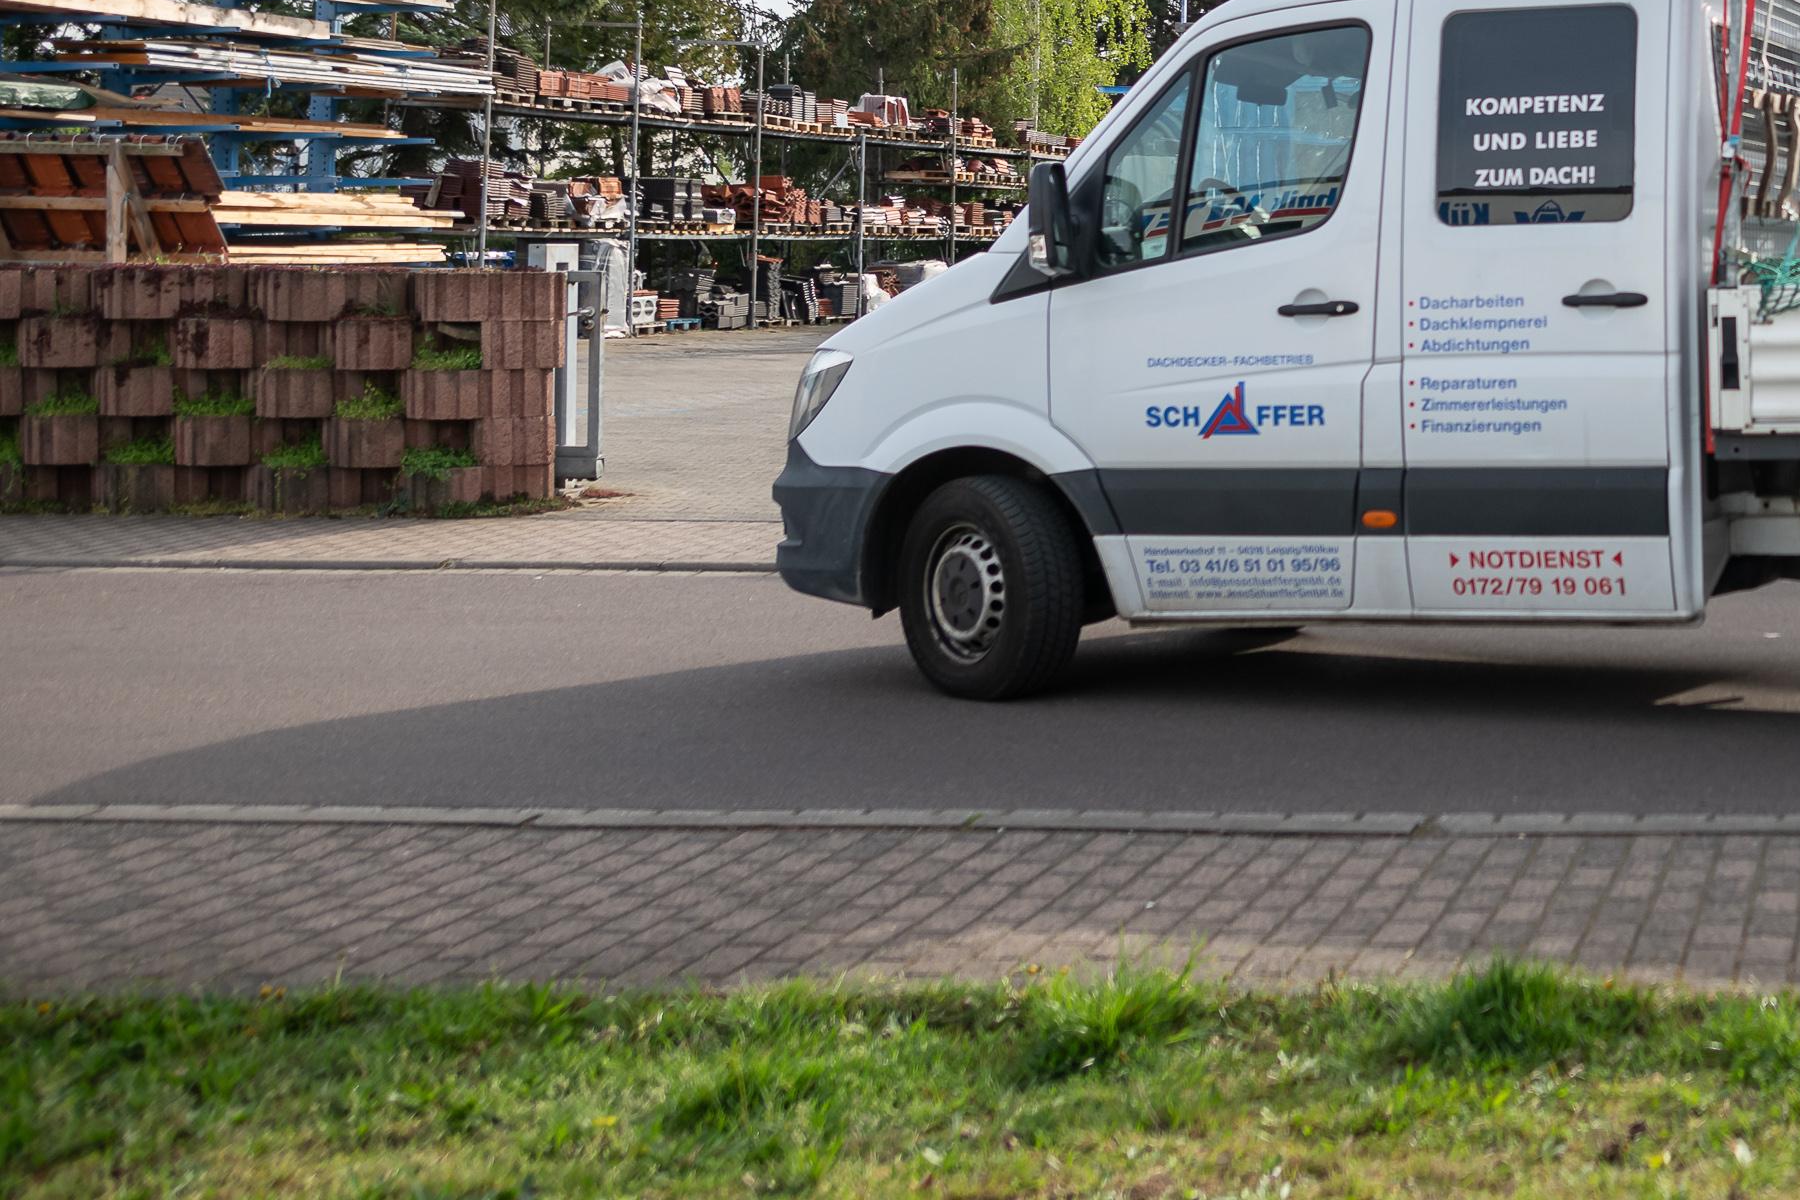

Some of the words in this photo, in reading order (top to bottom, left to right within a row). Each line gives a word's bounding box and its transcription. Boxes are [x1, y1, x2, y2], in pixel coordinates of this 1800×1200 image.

[1465, 94, 1605, 116] KOMPETENZ
[1473, 132, 1527, 151] UND
[1535, 130, 1598, 149] LIEBE
[1474, 168, 1524, 187] ZUM
[1529, 166, 1596, 186] DACH!
[1419, 296, 1525, 310] Dacharbeiten
[1419, 316, 1548, 331] Dachklempnerei
[1421, 339, 1530, 354] Abdichtungen
[1147, 354, 1314, 368] DACHDECKER-FACHBETRIEB
[1420, 376, 1518, 393] Reparaturen
[1421, 398, 1568, 414] Zimmererleistungen
[1421, 419, 1542, 435] Finanzierungen
[1146, 559, 1175, 574] Tel.
[1180, 558, 1200, 573] 03
[1205, 558, 1239, 573] 41/6
[1243, 558, 1261, 572] 51
[1267, 558, 1285, 572] 01
[1291, 557, 1341, 573] 95/96
[1469, 550, 1604, 569] NOTDIENST
[1452, 576, 1543, 597] 0172/79
[1552, 577, 1577, 596] 19
[1583, 576, 1627, 597] 061
